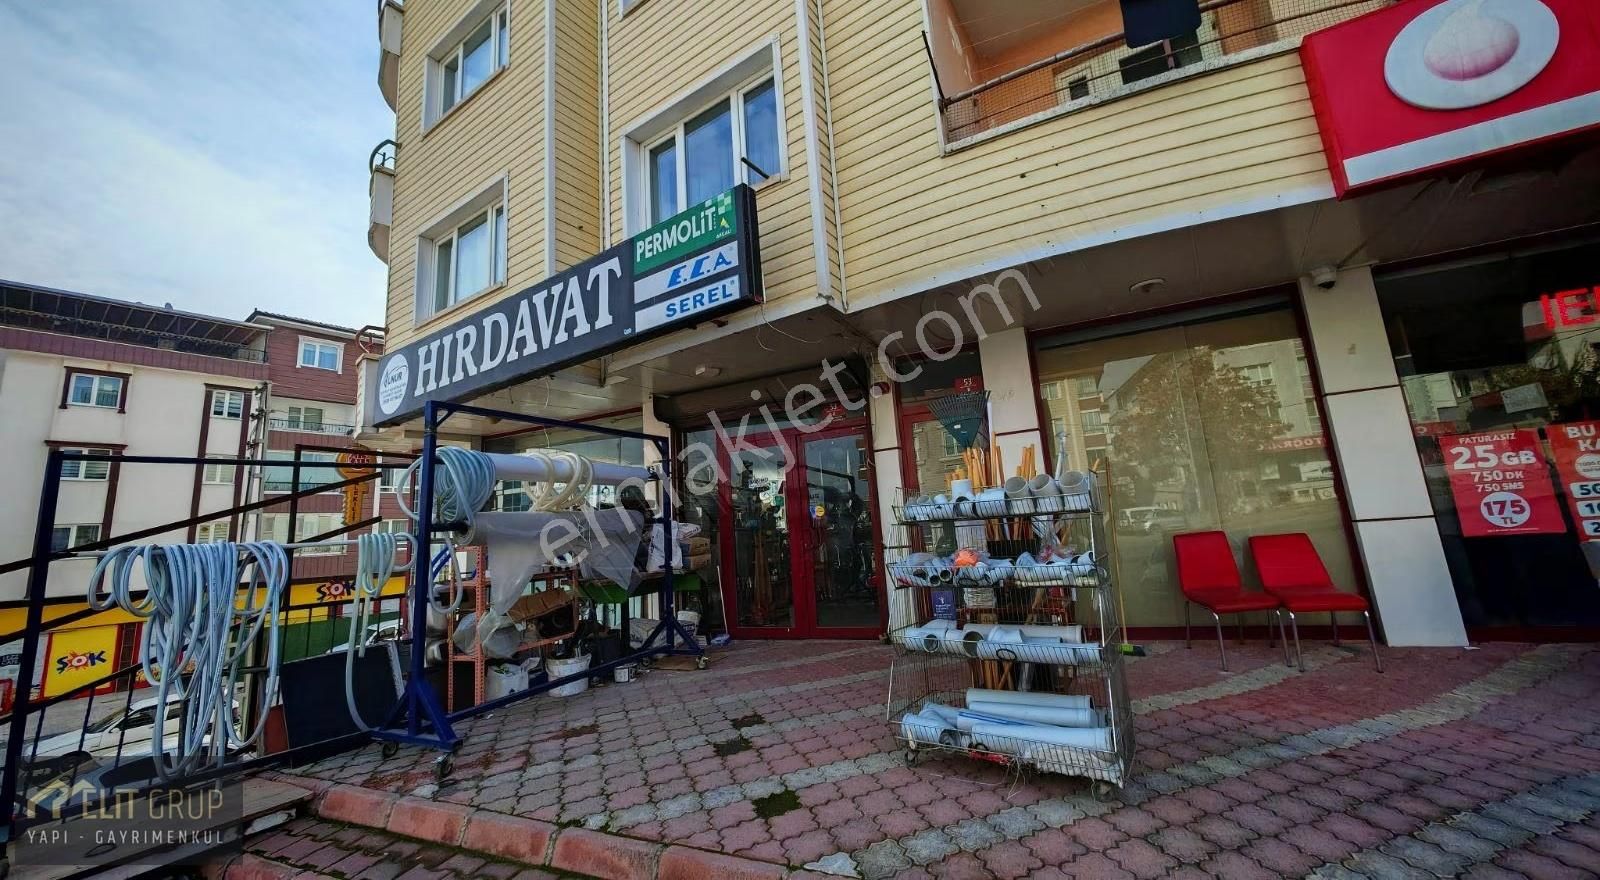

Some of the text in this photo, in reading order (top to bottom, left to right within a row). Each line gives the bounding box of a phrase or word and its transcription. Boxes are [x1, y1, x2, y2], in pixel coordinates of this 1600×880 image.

[665, 284, 733, 317] SEREL
[414, 257, 622, 398] HIRDAVAT
[1566, 424, 1596, 438] BU
[1459, 433, 1516, 444] FATURASIZ
[1450, 445, 1537, 470] 25 GB
[1471, 471, 1525, 482] 750 DK
[1475, 482, 1524, 492] 750 SMS
[1484, 500, 1526, 516] 175
[1501, 517, 1518, 525] TL
